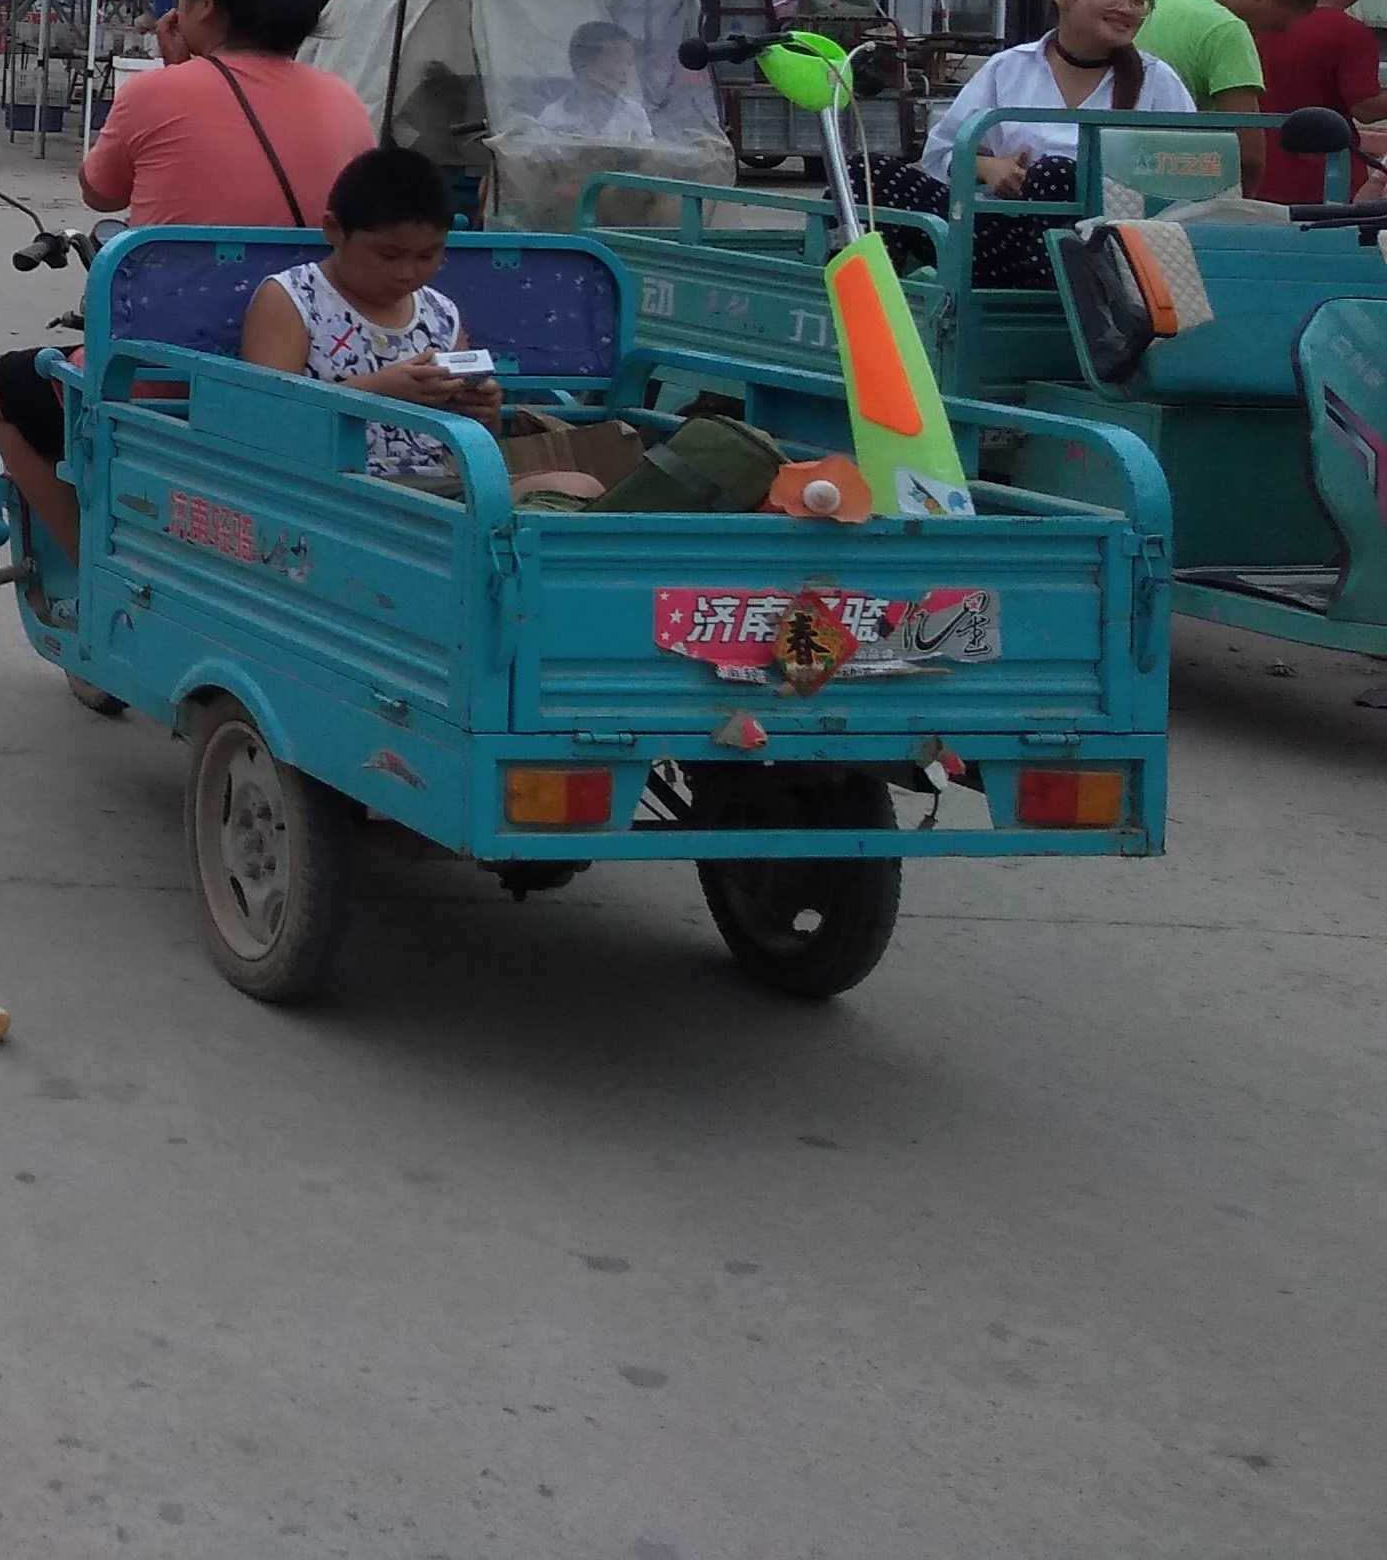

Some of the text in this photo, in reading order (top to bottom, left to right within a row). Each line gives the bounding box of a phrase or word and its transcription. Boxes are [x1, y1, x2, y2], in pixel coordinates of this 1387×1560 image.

[686, 596, 890, 644] 济南骑
[786, 612, 832, 665] 春
